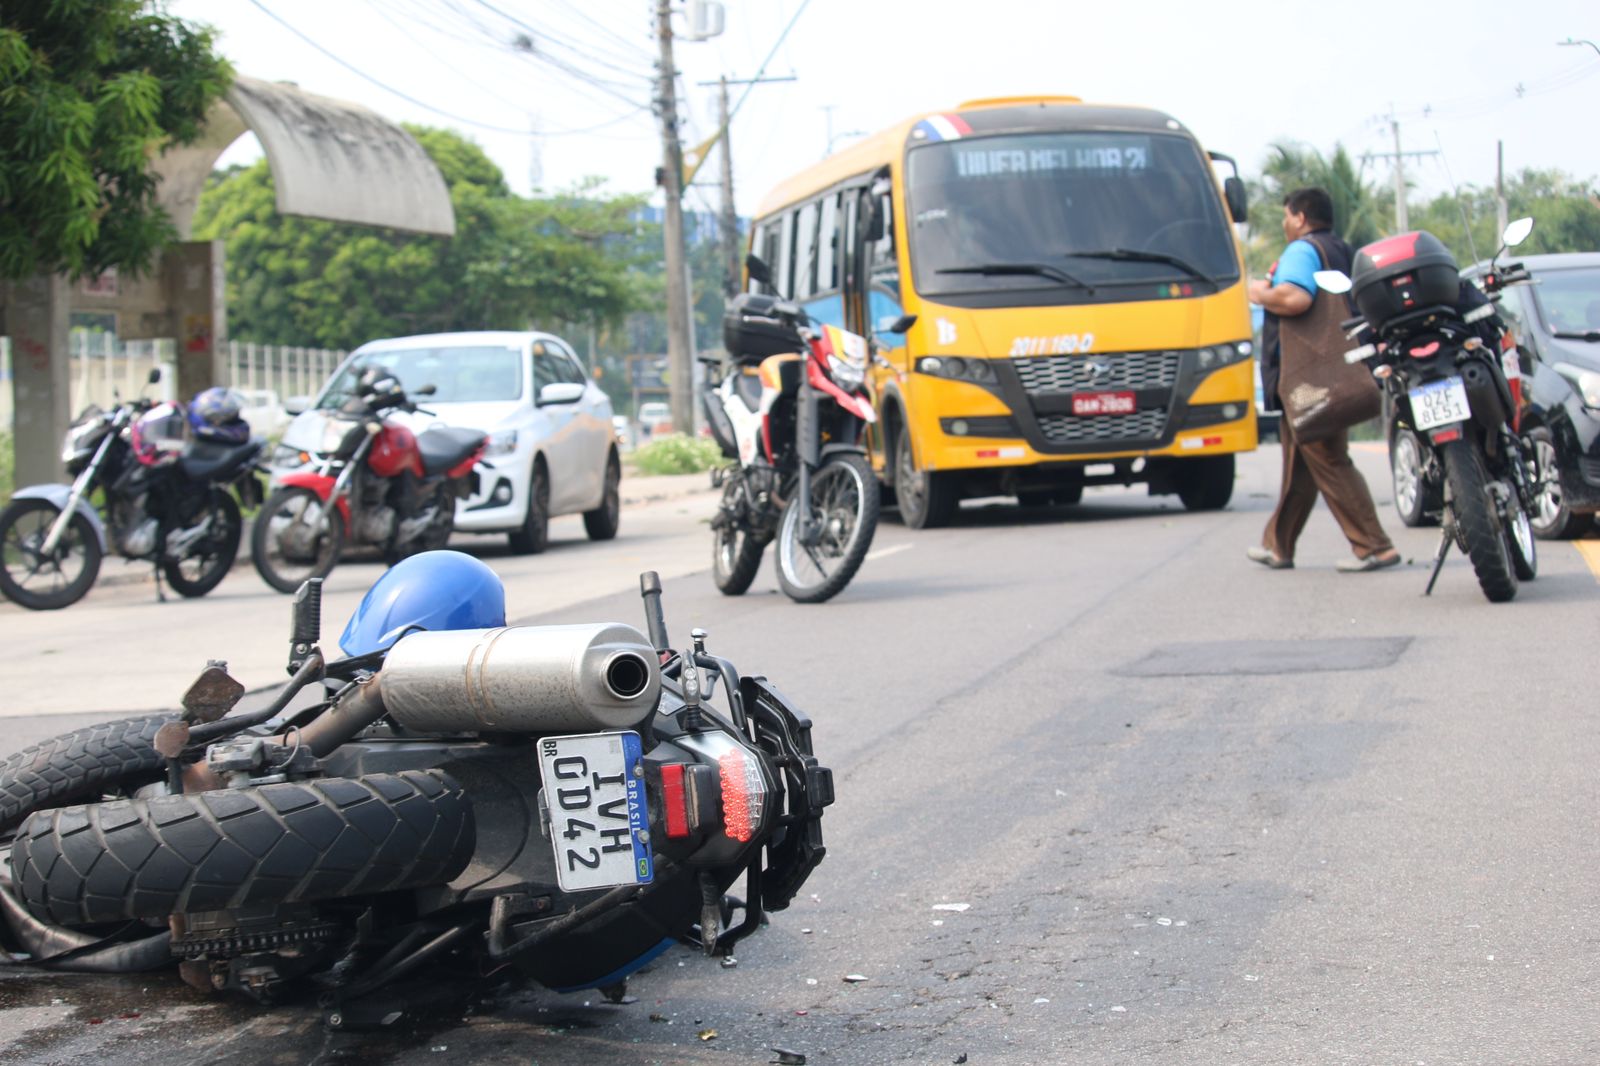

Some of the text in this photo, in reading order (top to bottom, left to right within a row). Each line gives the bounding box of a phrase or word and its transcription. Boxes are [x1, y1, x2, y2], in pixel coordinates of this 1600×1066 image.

[543, 740, 558, 757] BR
[592, 771, 633, 853] IVH
[627, 780, 641, 835] BRASIL
